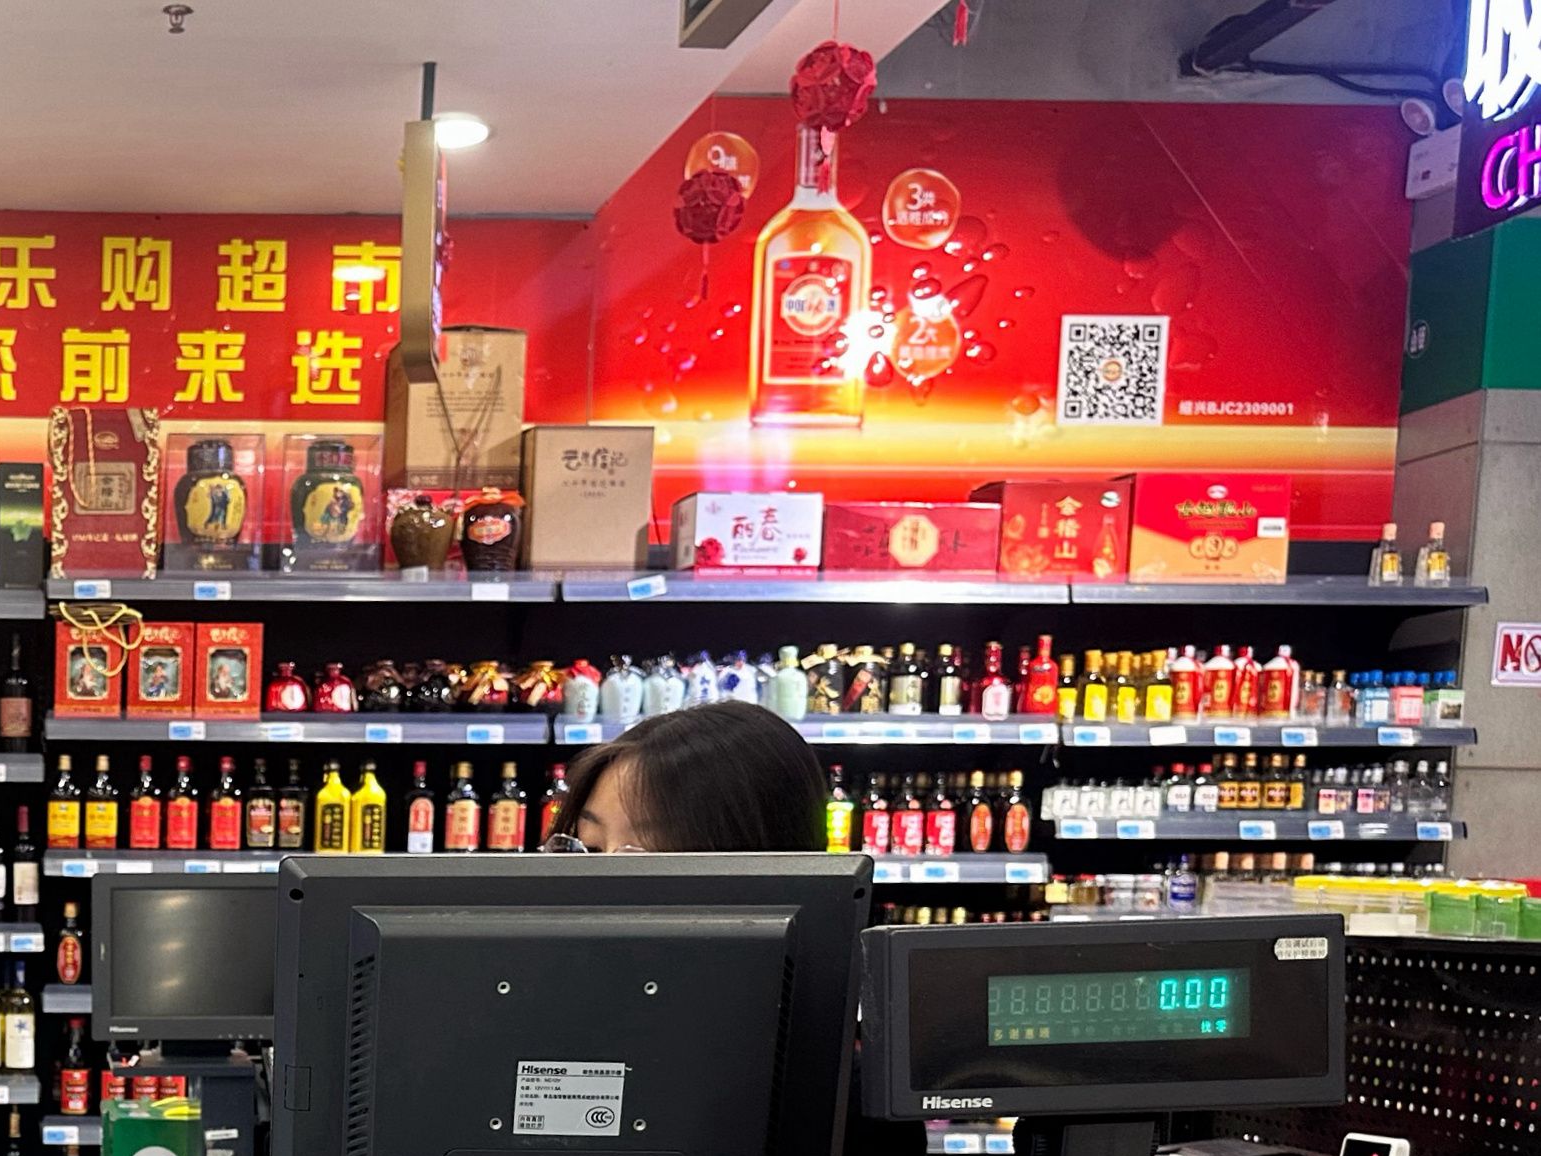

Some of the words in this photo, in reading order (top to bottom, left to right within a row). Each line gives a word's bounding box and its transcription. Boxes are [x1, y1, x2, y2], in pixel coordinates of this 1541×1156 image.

[1160, 978, 1228, 1011] 0.00
[1201, 1020, 1227, 1033] 找零
[522, 1065, 568, 1075] Hisense
[922, 1095, 993, 1110] Hisense
